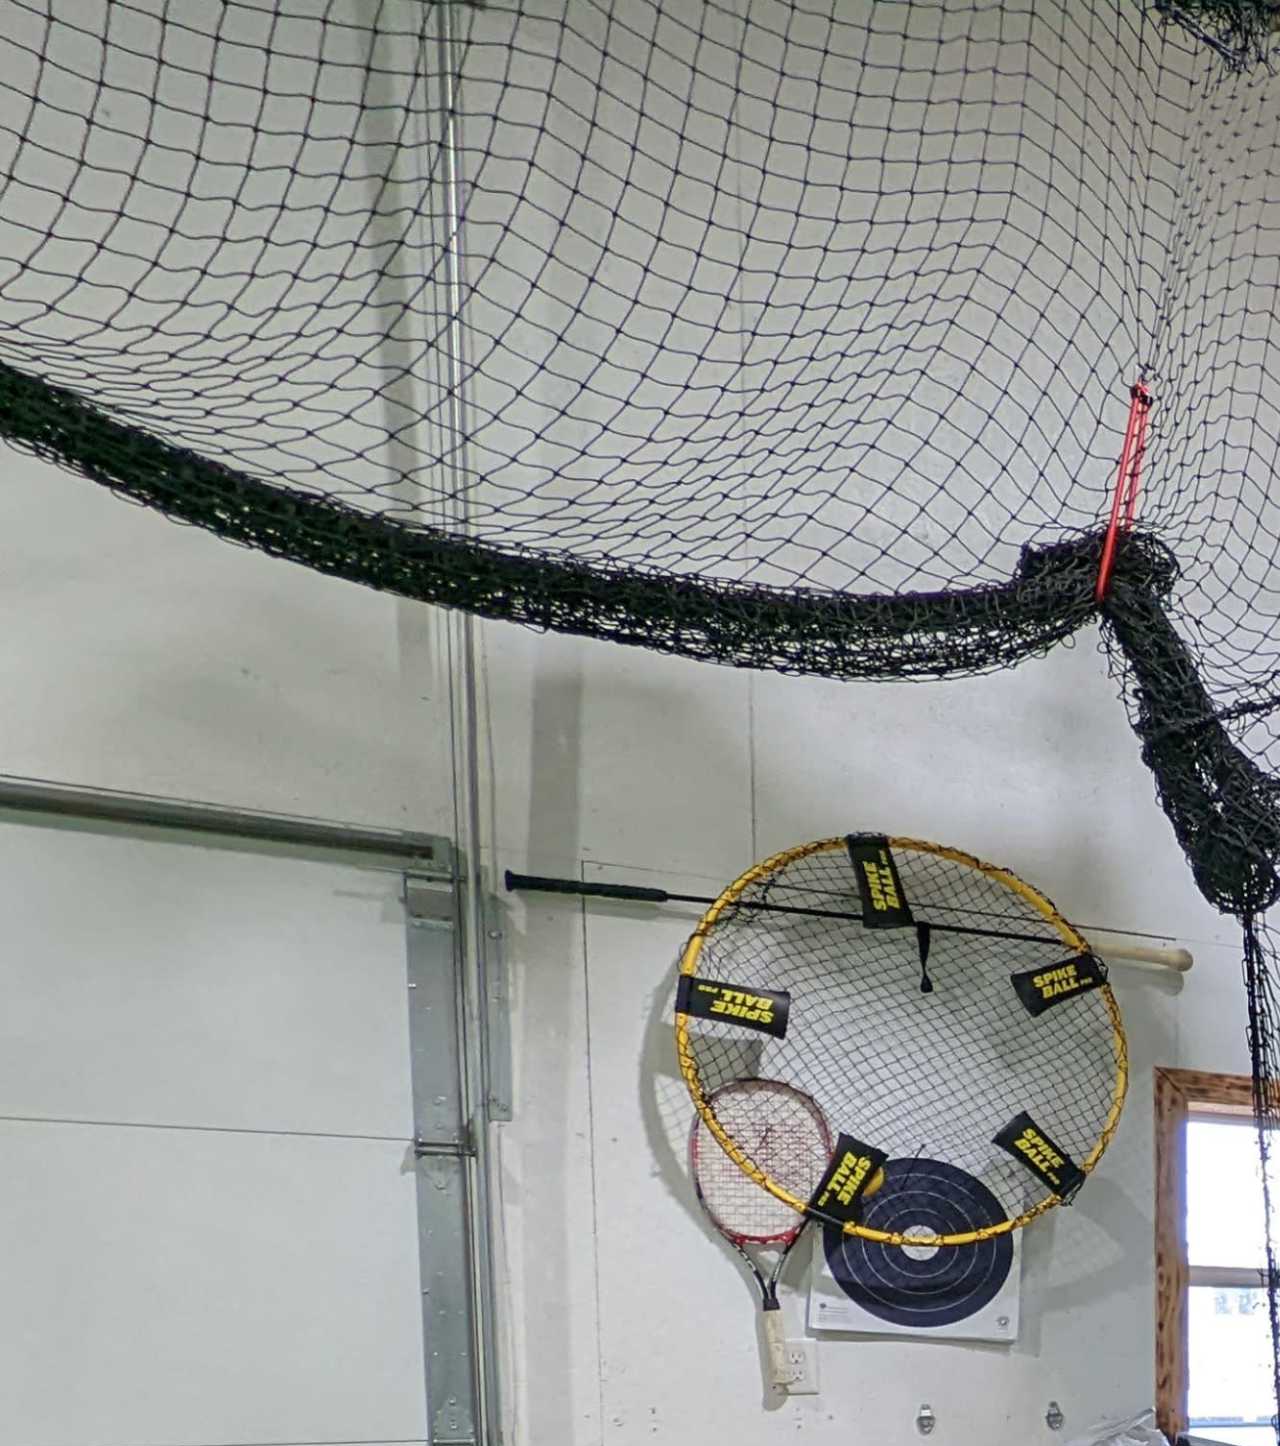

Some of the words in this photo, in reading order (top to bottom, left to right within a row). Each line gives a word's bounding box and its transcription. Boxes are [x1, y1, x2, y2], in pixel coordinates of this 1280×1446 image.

[863, 861, 887, 911] SPIKE
[879, 867, 900, 909] BALL
[1033, 964, 1077, 988] SPIKE
[1042, 977, 1079, 999] BALL
[710, 1000, 774, 1024] SPIKE
[721, 989, 774, 1010] BALL
[1013, 1138, 1051, 1173] BALL
[1023, 1128, 1065, 1168] SPIKE
[827, 1151, 858, 1193] BALL
[837, 1156, 872, 1206] SPIKE
